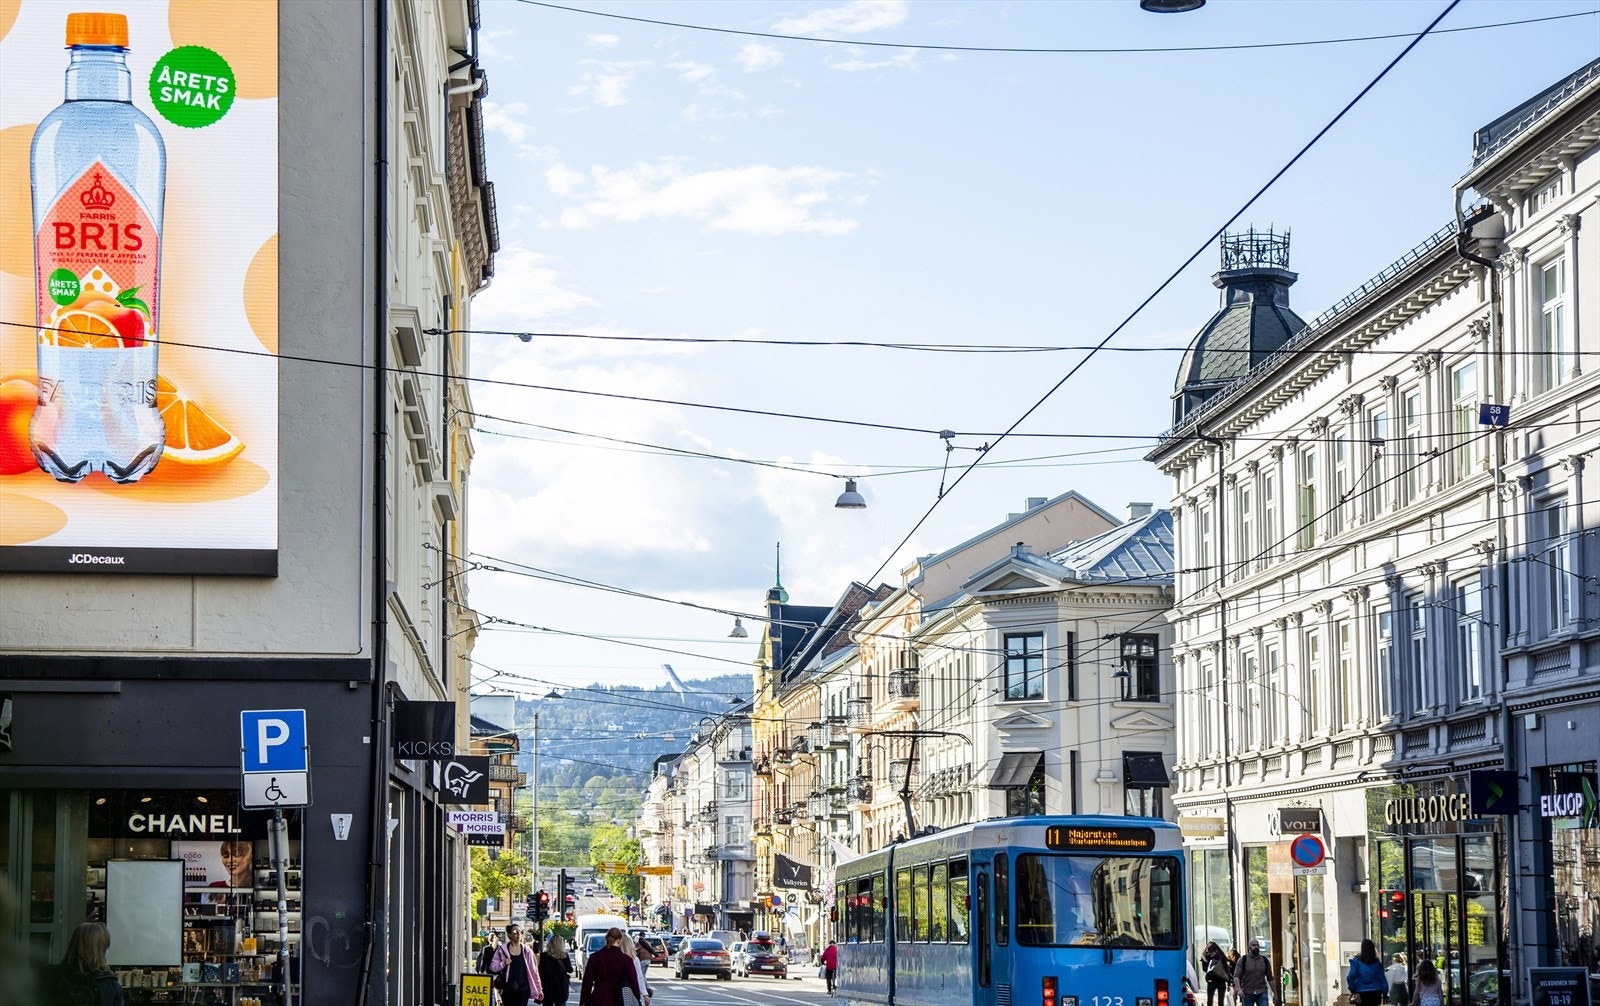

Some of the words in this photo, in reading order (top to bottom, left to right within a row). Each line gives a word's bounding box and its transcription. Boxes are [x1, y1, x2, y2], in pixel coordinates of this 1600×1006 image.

[157, 66, 229, 94] ÅRETS
[160, 87, 221, 110] SMAK
[52, 222, 143, 251] BRIS
[50, 279, 77, 289] ÅRETS
[1490, 406, 1501, 414] 58
[1491, 416, 1498, 424] V
[69, 554, 124, 565] JCDecaux
[258, 718, 290, 764] P
[398, 741, 452, 755] KICKS
[128, 814, 242, 833] CHANEL
[1200, 823, 1221, 831] BOK
[1283, 821, 1318, 830] VOLT
[1048, 829, 1059, 845] 11
[1068, 829, 1118, 839] Majorstuen
[783, 878, 808, 887] Valkyrien
[465, 986, 488, 994] SALE
[467, 998, 485, 1006] 70%
[1550, 995, 1571, 1005] 10-19
